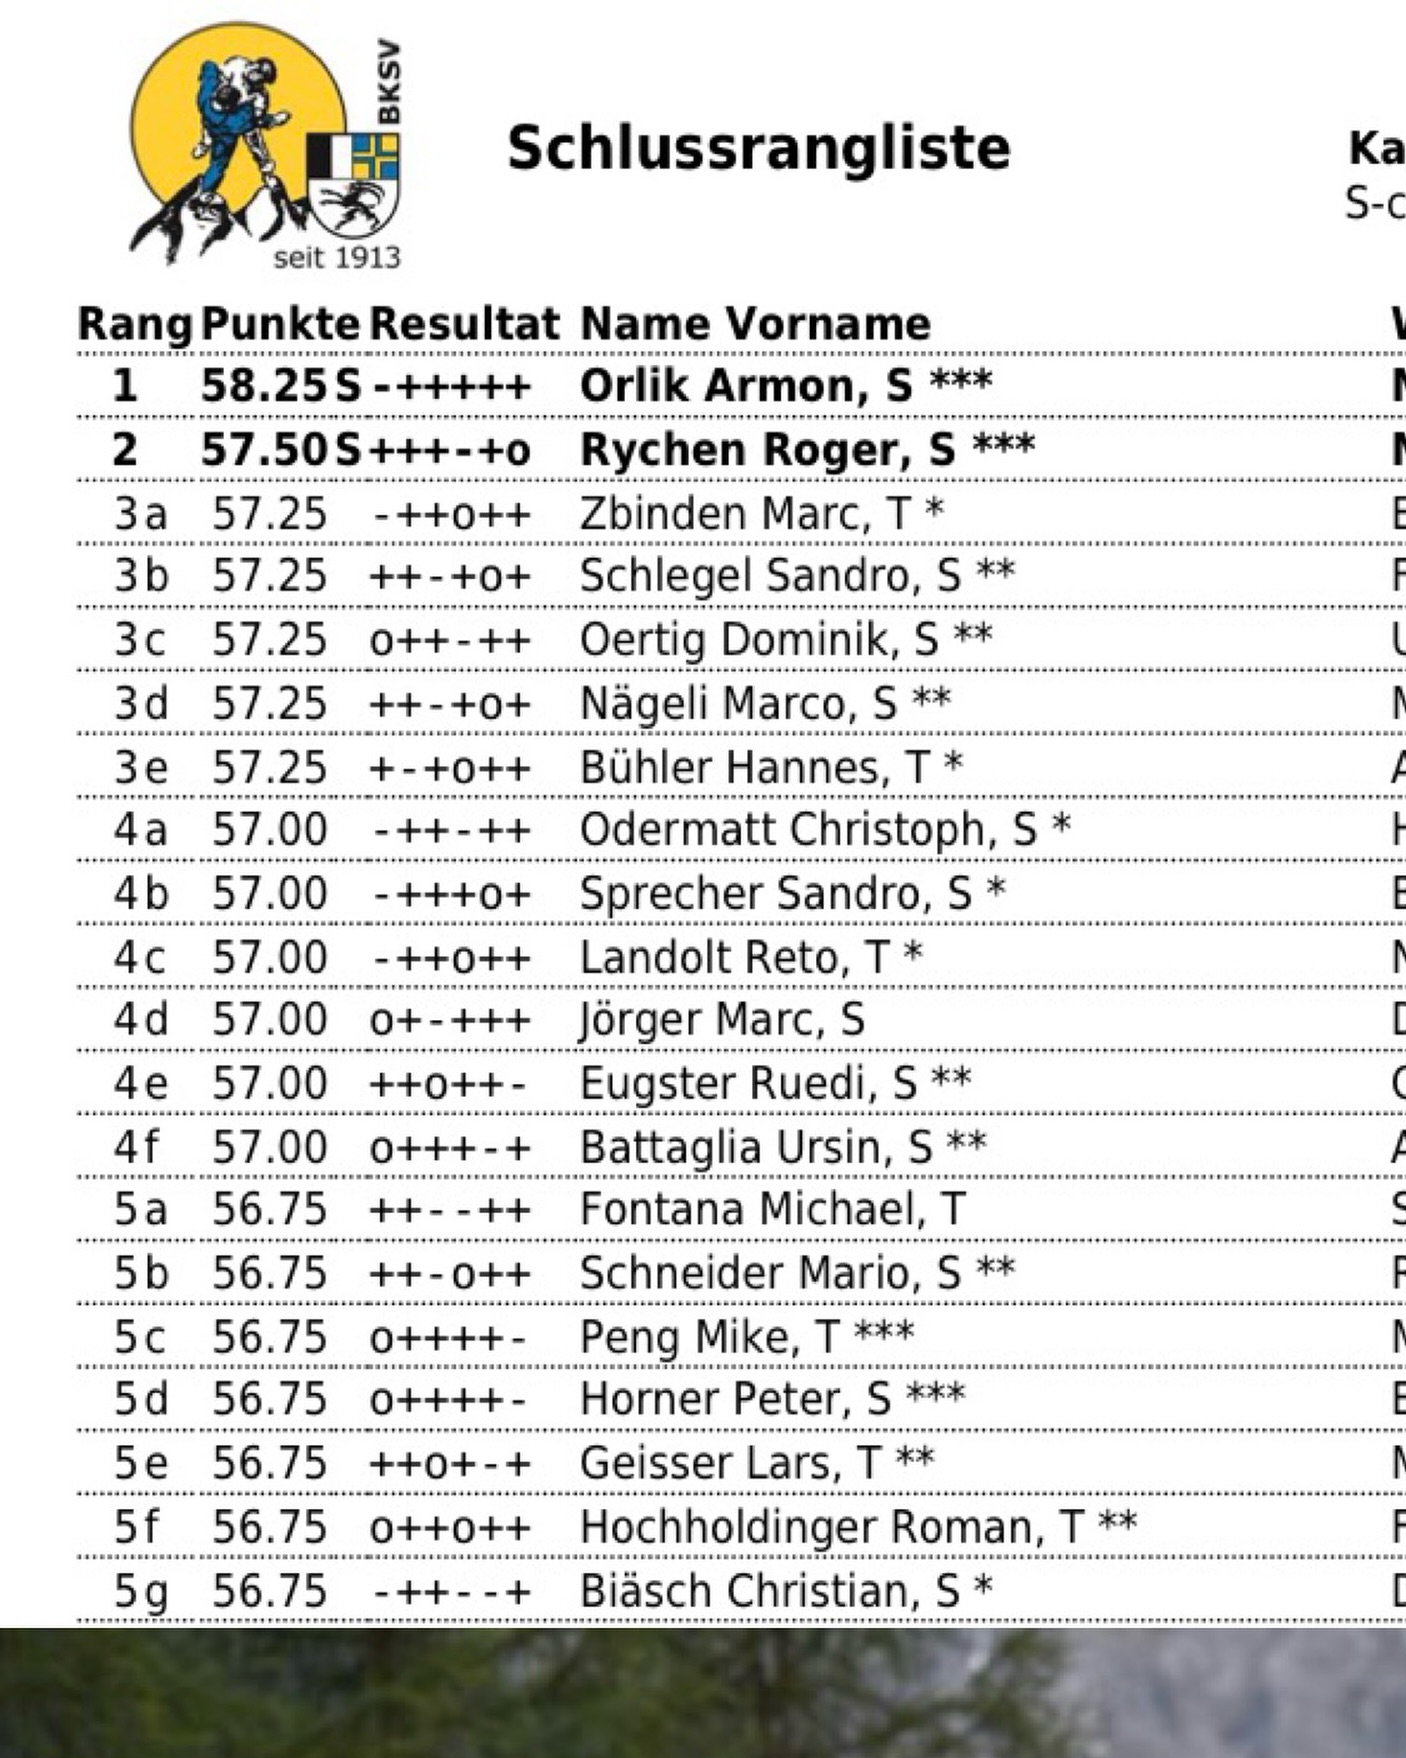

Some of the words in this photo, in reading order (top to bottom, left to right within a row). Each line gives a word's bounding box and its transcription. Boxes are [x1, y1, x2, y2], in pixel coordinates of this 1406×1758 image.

[377, 38, 401, 124] BKSV
[509, 121, 1011, 183] Schlussrangliste
[274, 246, 325, 269] seit
[337, 245, 401, 269] 1913
[79, 306, 192, 349] Rang
[202, 304, 361, 340] Punkte
[371, 304, 560, 341] Resultat
[582, 306, 710, 340] Name
[725, 306, 931, 341] Vorname
[202, 367, 327, 402] 58.25
[581, 365, 690, 402] Orlik
[704, 367, 868, 409] Armon,
[202, 431, 328, 466] 57.50
[582, 429, 745, 475] Rychen
[764, 432, 911, 475] Roger,
[581, 494, 745, 530] Zbinden
[764, 496, 870, 535] Marc,
[214, 557, 326, 592] 57.25
[581, 555, 750, 601] Schlegel
[768, 555, 920, 597] Sandro,
[581, 619, 705, 665] Oertig
[724, 619, 899, 661] Dominik,
[214, 685, 326, 720] 57.25
[583, 683, 706, 729] Nägeli
[724, 685, 856, 725] Marco,
[583, 748, 713, 784] Bühler
[728, 750, 889, 789] Hannes,
[214, 811, 327, 846] 57.00
[581, 809, 776, 846] Odermatt
[791, 809, 996, 855] Christoph,
[214, 875, 327, 910] 57.00
[581, 873, 764, 919] Sprecher
[778, 874, 931, 914] Sandro,
[583, 938, 731, 974] Landolt
[747, 939, 849, 979] Reto,
[214, 1001, 327, 1036] 57.00
[577, 999, 703, 1044] Jörger
[718, 1001, 824, 1040] Marc,
[583, 1065, 736, 1108] Eugster
[752, 1063, 876, 1104] Ruedi,
[214, 1129, 327, 1164] 57.00
[583, 1127, 760, 1173] Battaglia
[779, 1127, 892, 1168] Ursin,
[583, 1191, 743, 1225] Fontana
[762, 1189, 925, 1230] Michael,
[214, 1255, 326, 1290] 56.75
[581, 1253, 784, 1290] Schneider
[800, 1253, 920, 1294] Mario,
[583, 1319, 679, 1362] Peng
[698, 1317, 799, 1358] Mike,
[214, 1380, 326, 1416] 56.75
[583, 1381, 720, 1415] Horner
[736, 1381, 850, 1420] Peter,
[581, 1443, 734, 1480] Geisser
[748, 1445, 840, 1484] Lars,
[214, 1509, 326, 1544] 56.75
[583, 1507, 878, 1552] Hochholdinger
[893, 1509, 1043, 1548] Roman,
[214, 1573, 326, 1608] 56.75
[583, 1571, 710, 1608] Biäsch
[728, 1571, 919, 1612] Christian,
